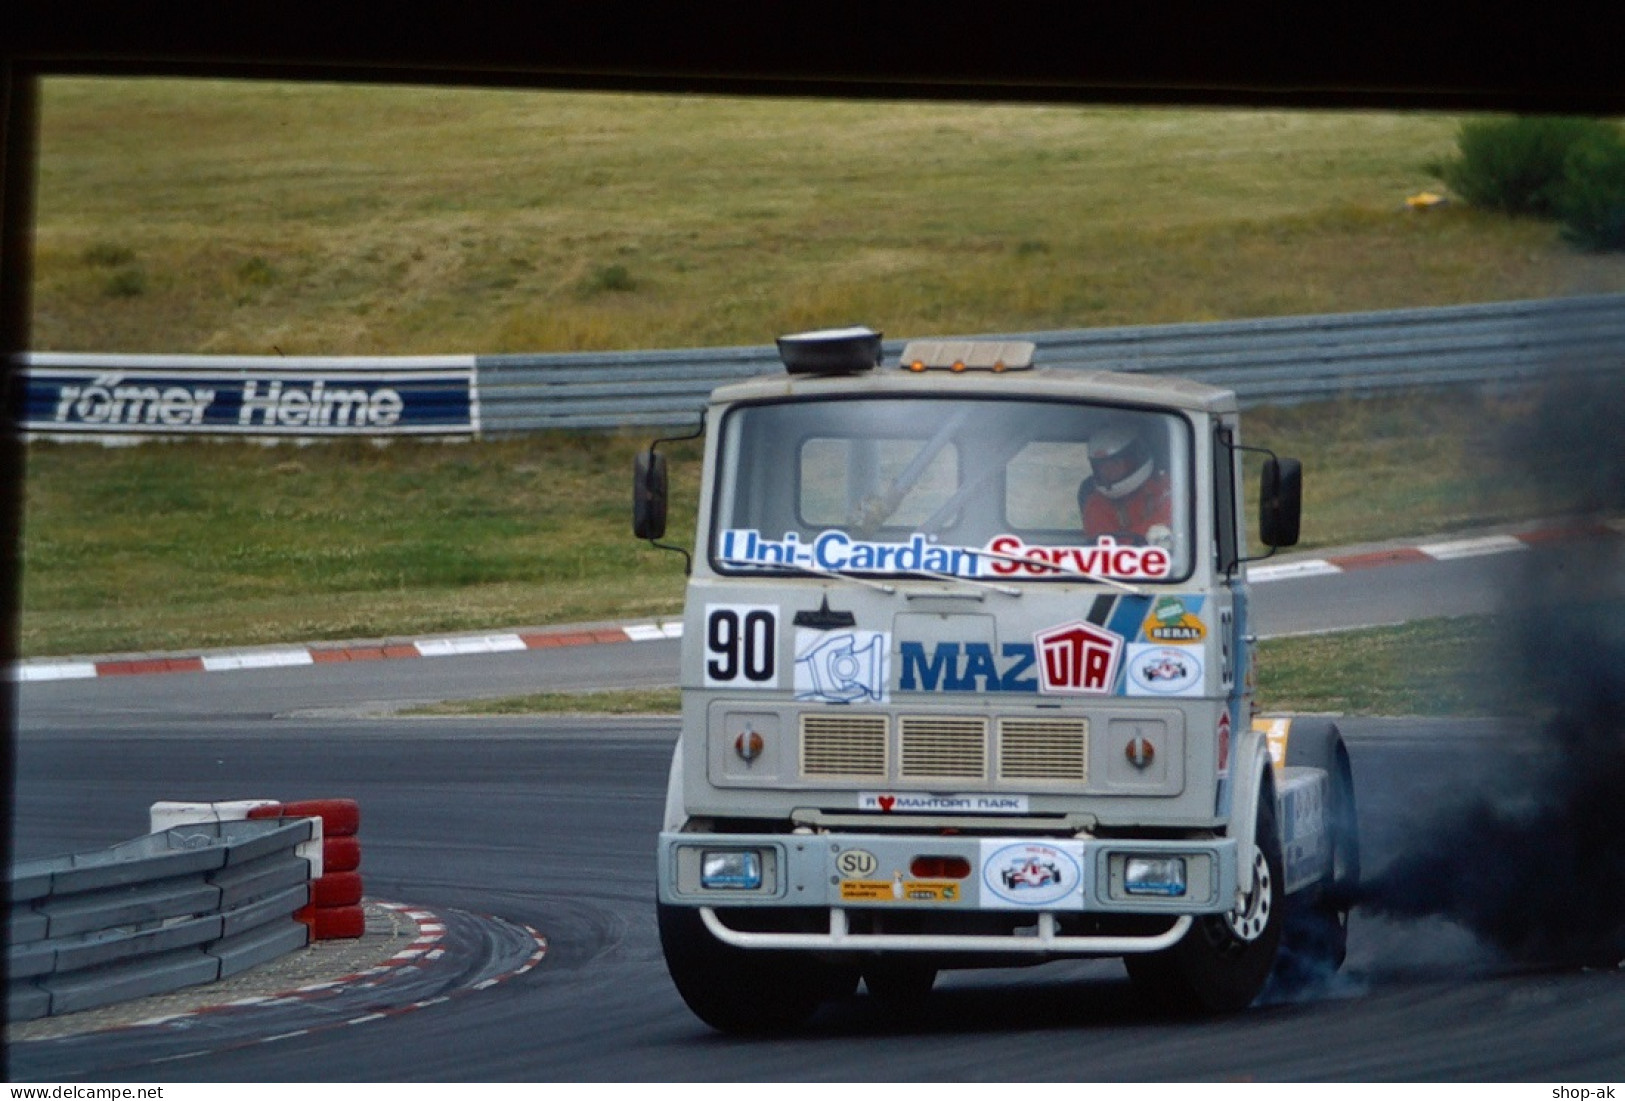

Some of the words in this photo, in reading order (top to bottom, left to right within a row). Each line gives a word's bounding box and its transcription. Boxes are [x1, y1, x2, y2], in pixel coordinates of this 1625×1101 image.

[722, 531, 978, 575] Uni-Cardan
[990, 537, 1167, 577] Service
[708, 609, 775, 682] 90
[899, 640, 1038, 692] MAZ
[1043, 627, 1113, 689] UTA
[977, 798, 1019, 809] ПАРК
[843, 854, 871, 873] SU
